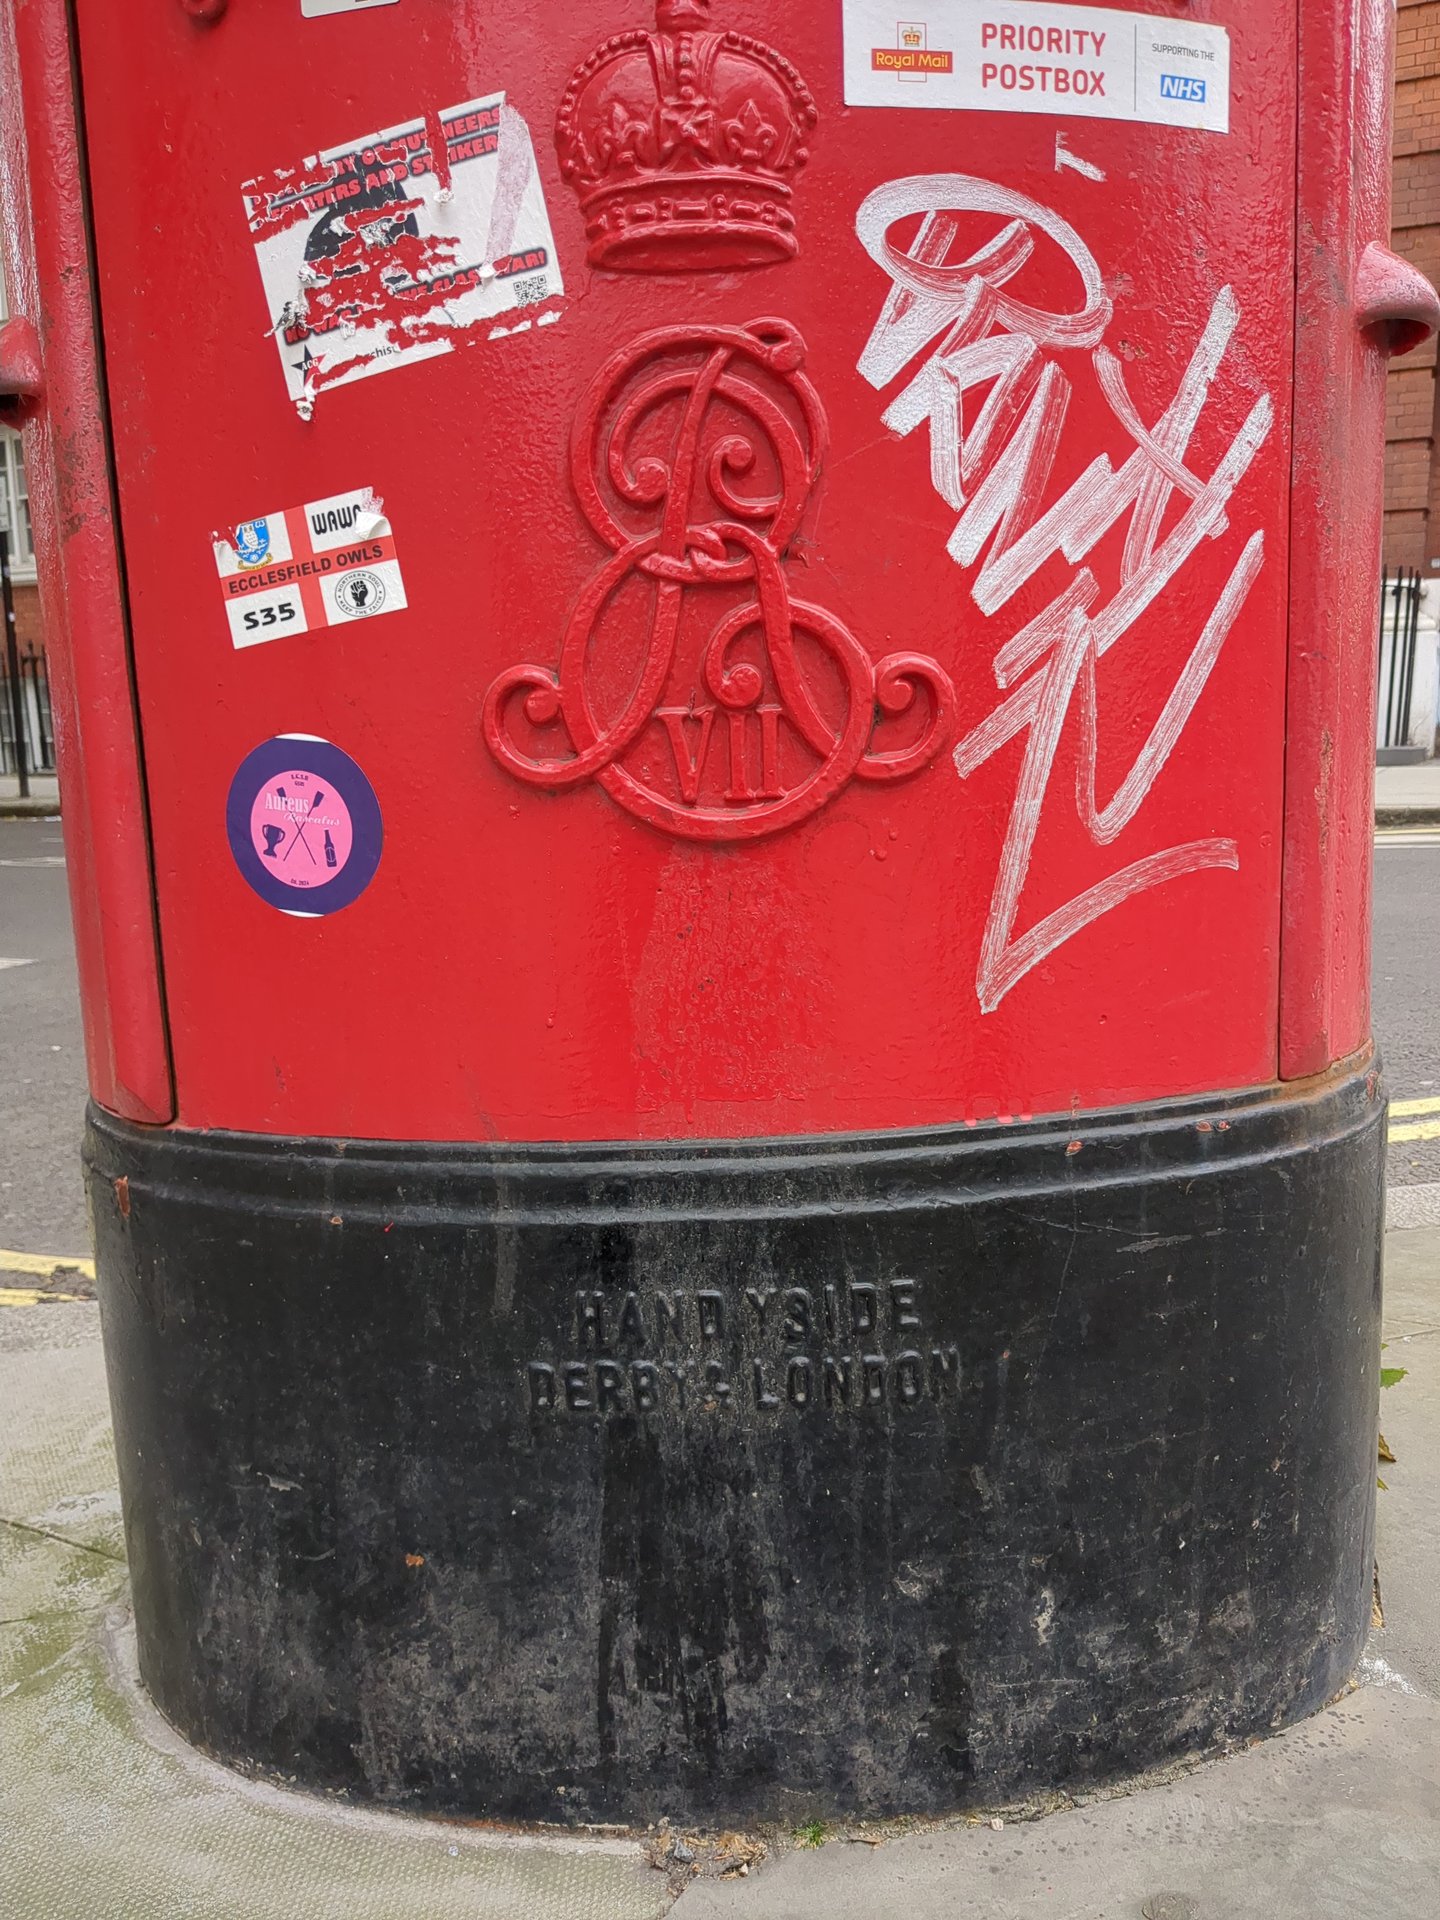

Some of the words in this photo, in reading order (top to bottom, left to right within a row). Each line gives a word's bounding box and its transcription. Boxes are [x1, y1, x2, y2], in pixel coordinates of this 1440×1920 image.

[981, 22, 1107, 57] PRIORITY
[1151, 43, 1199, 59] SUPPORTING
[1200, 50, 1215, 61] THE
[876, 52, 915, 69] Royal
[918, 54, 948, 68] Mail
[981, 62, 1106, 97] POSTBOX
[1162, 76, 1204, 101] NHS
[228, 557, 332, 594] ECCLESFIELD
[336, 544, 383, 567] OWLS
[243, 602, 296, 631] S35
[265, 792, 309, 813] Aureus
[753, 1347, 962, 1411] LONDON
